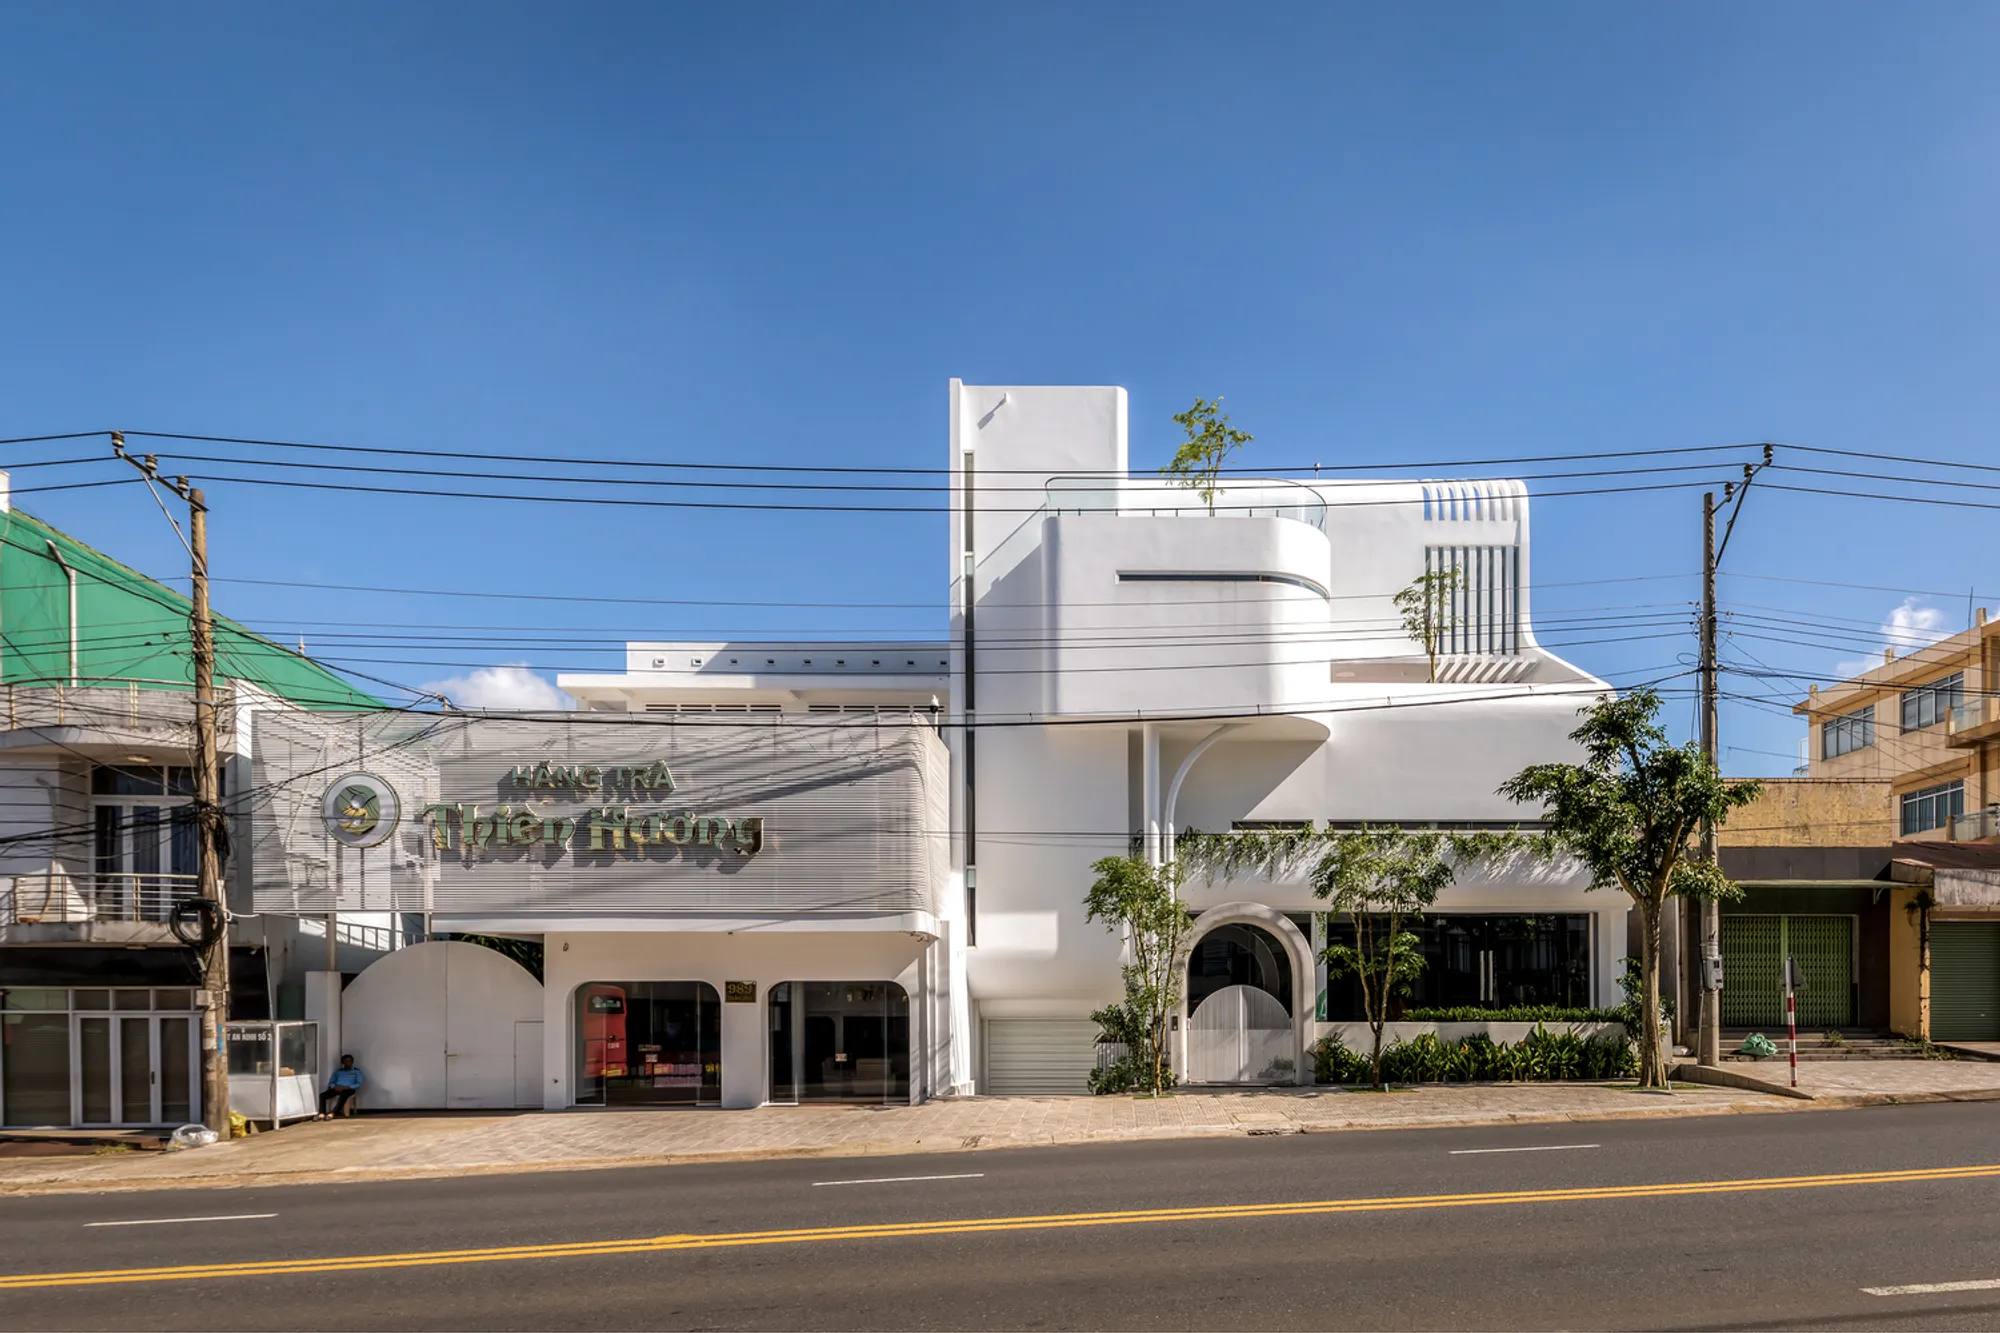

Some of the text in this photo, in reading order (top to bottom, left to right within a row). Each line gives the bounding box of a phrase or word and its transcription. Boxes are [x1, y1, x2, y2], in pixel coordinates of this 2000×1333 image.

[611, 758, 678, 789] TRÀ
[422, 801, 766, 857] Thiên Hương
[727, 983, 752, 995] 989
